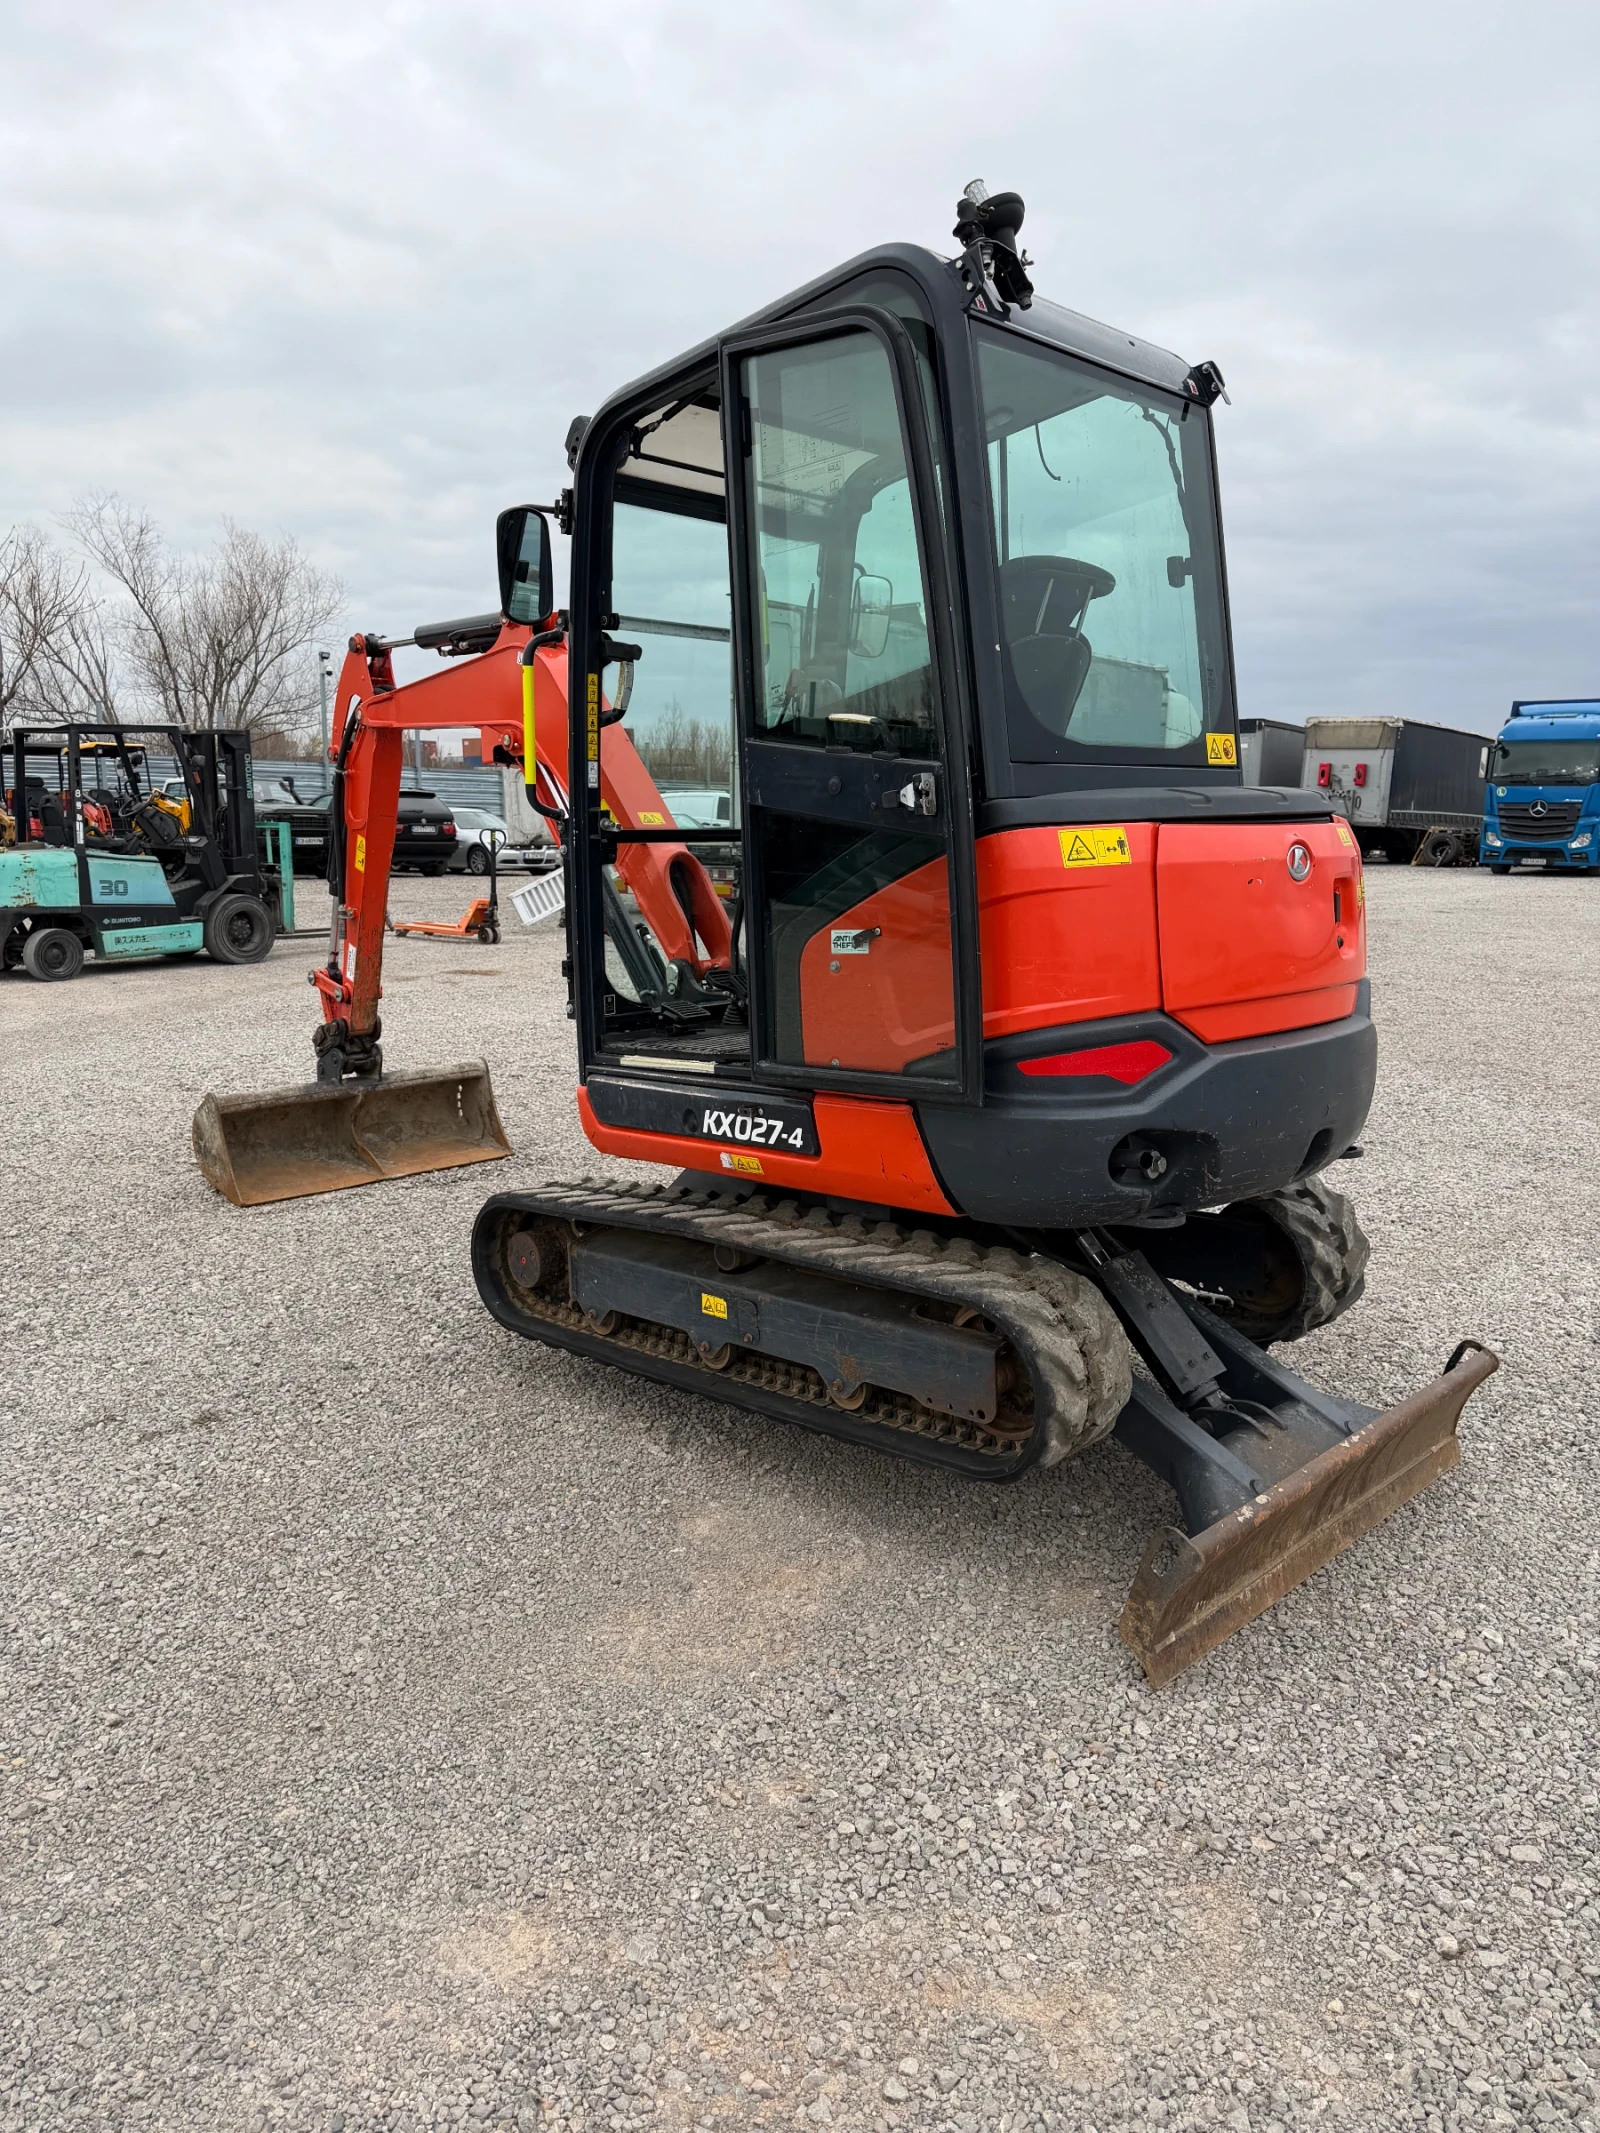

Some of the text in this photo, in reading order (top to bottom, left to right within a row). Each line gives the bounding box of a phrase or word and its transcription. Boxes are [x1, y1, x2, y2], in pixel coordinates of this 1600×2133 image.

[244, 753, 253, 799] SUMITOMO
[99, 880, 128, 896] 30
[111, 916, 142, 924] SUMITOMO
[702, 1109, 804, 1149] KX027-4
